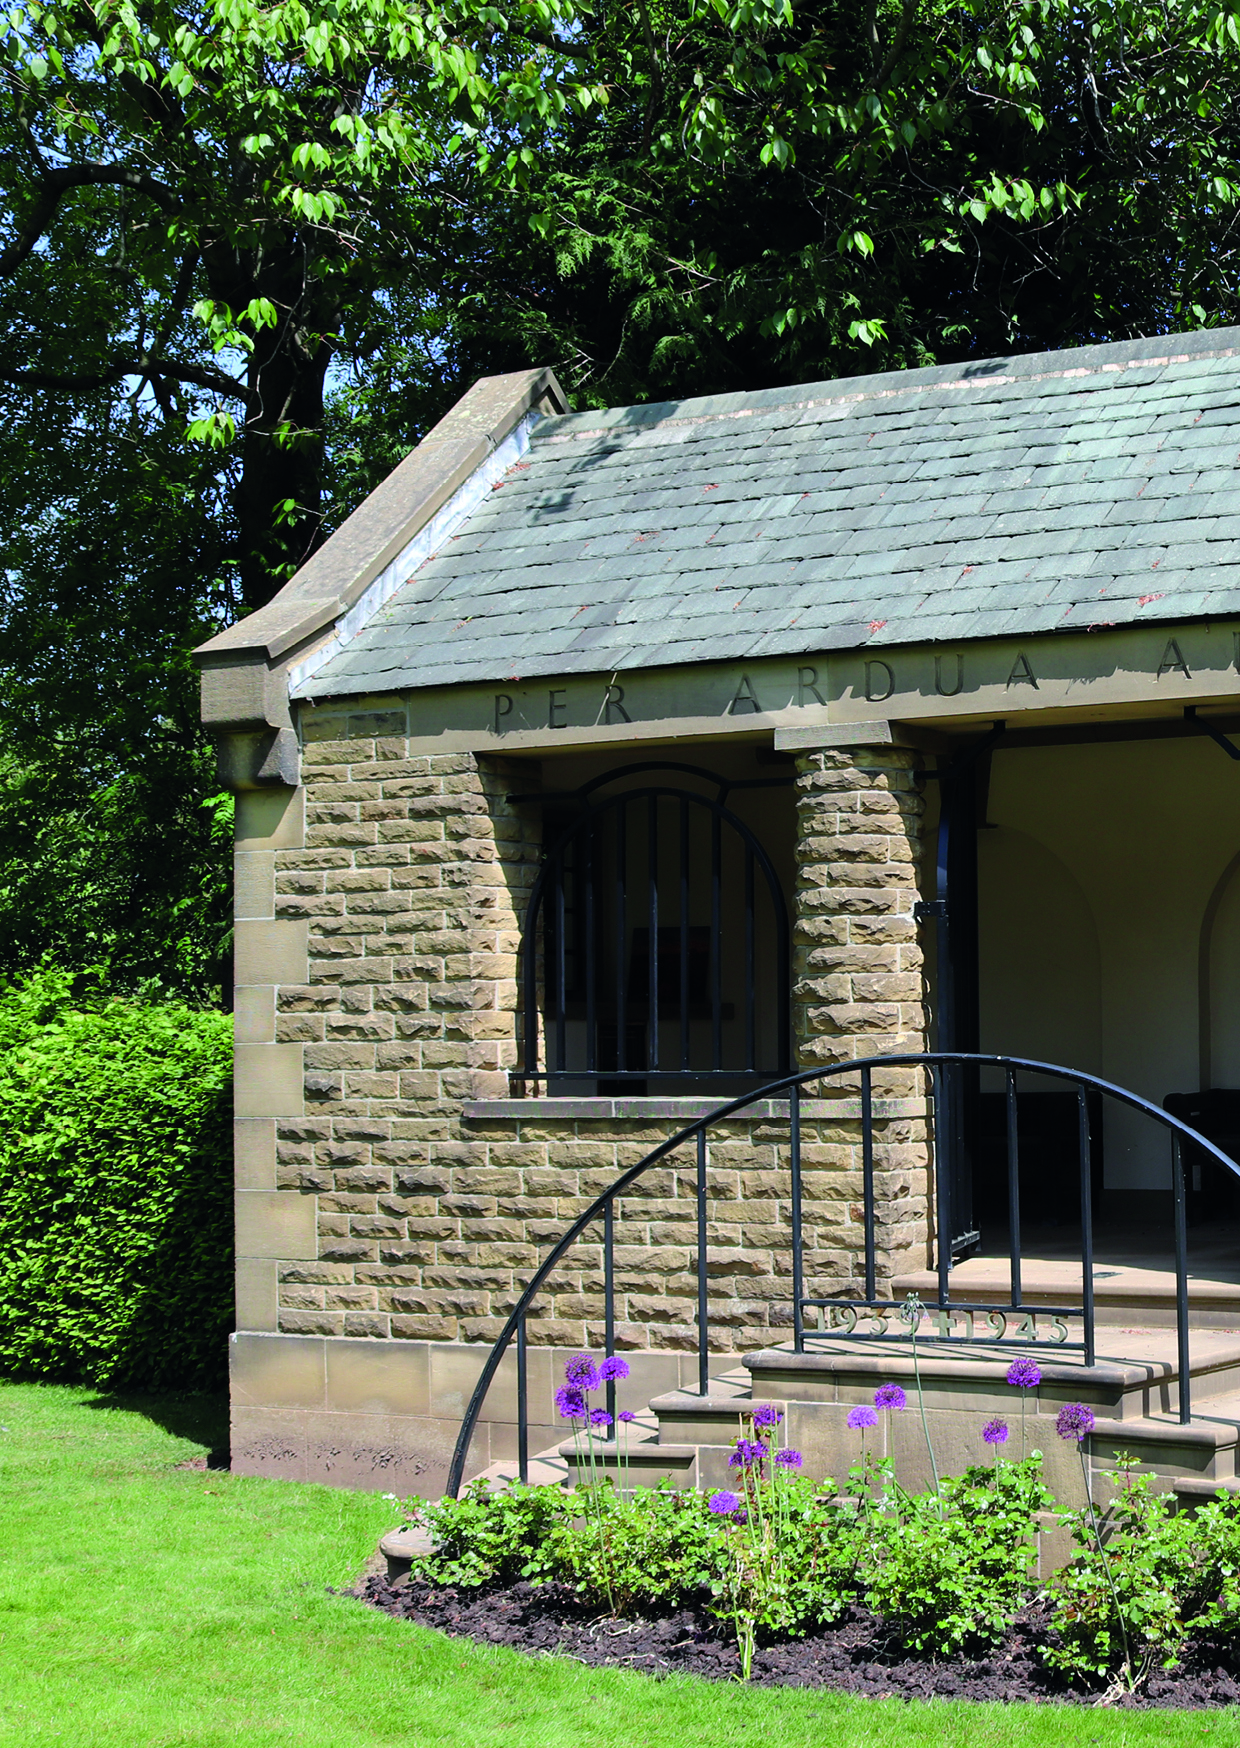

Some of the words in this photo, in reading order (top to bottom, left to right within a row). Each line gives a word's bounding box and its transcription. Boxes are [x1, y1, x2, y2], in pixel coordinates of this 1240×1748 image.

[493, 685, 631, 730] PER
[729, 652, 1040, 714] ARDUA
[817, 1305, 920, 1337] 1939
[963, 1310, 1069, 1343] 1945
